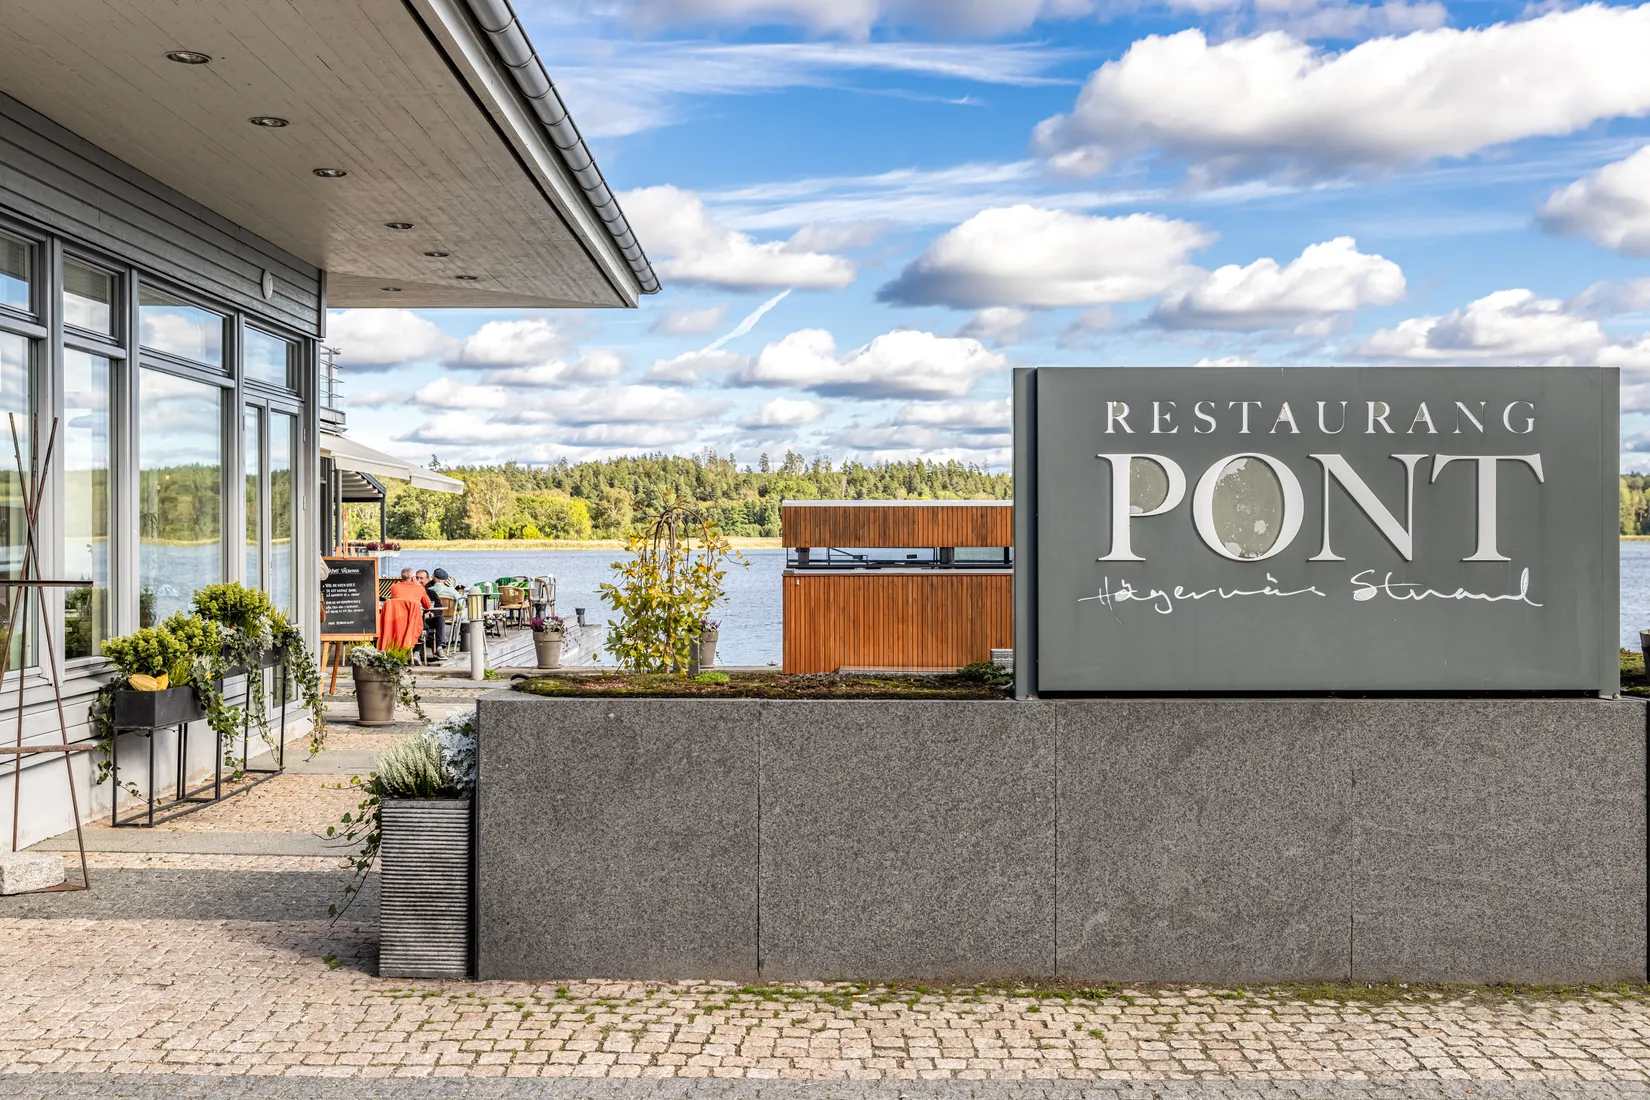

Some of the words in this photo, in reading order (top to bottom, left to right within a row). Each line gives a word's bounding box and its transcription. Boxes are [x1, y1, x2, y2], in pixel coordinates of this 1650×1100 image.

[1104, 401, 1536, 434] RESTAURANG
[1096, 452, 1545, 562] PONT
[1350, 567, 1544, 608] Strand
